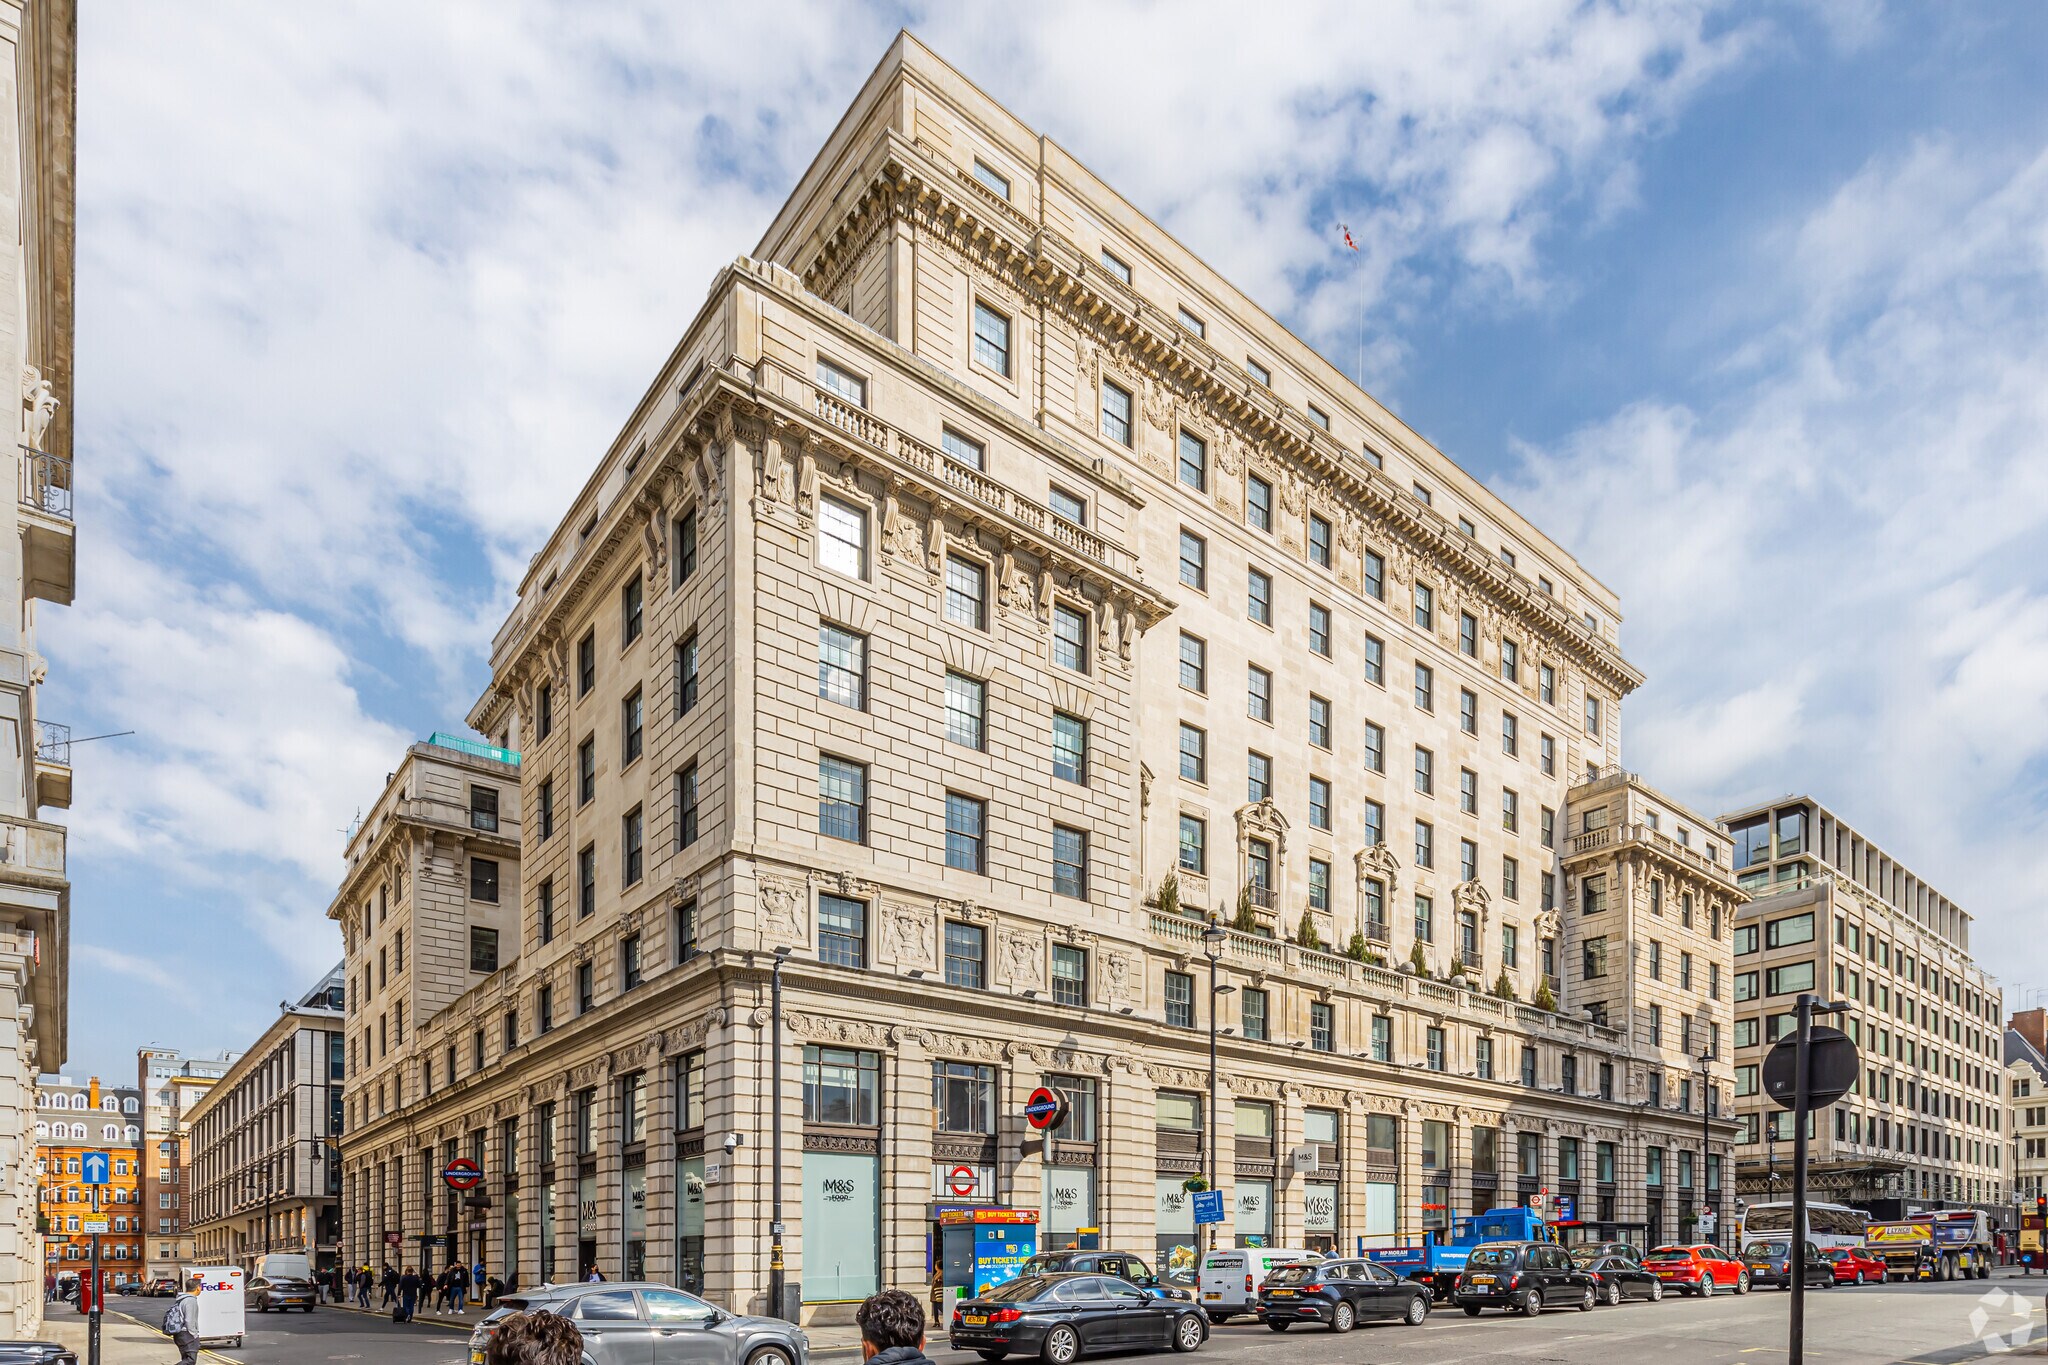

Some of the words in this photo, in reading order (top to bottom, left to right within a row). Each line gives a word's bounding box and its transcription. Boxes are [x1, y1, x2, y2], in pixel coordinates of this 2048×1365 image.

[1026, 1103, 1056, 1113] UNDERGROUND
[688, 1182, 702, 1195] M&S
[826, 1179, 854, 1192] M&S
[1055, 1188, 1077, 1199] M&S
[1166, 1193, 1185, 1203] M&S
[1243, 1196, 1259, 1205] M&S
[1019, 1256, 1031, 1264] HE
[1208, 1260, 1242, 1268] enterprise
[201, 1282, 234, 1291] FedEx
